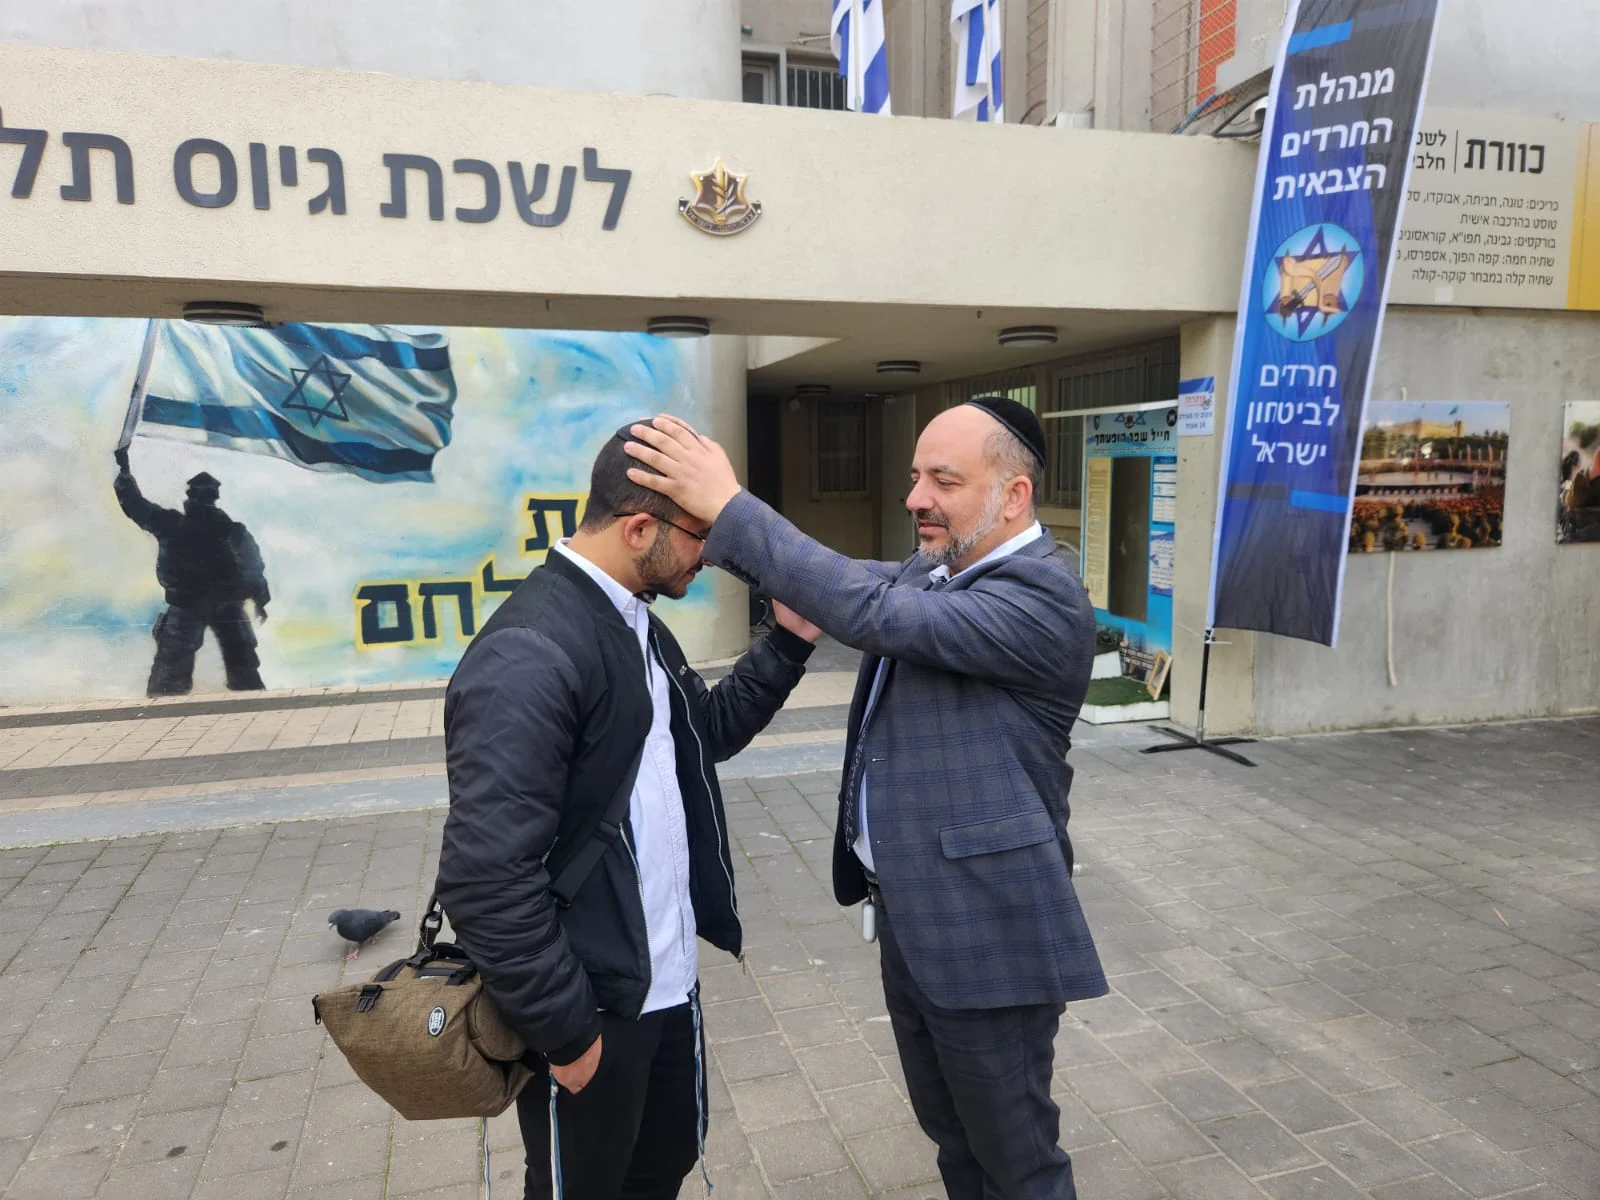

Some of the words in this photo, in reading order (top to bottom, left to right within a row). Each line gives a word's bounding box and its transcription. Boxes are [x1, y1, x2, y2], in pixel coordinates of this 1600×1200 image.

[1293, 67, 1395, 110] מנהלת
[1280, 117, 1394, 158] החרדים
[1416, 129, 1447, 147] לשכ
[0, 105, 135, 205] תל
[1463, 138, 1545, 174] כוורת
[172, 137, 346, 215] גיוס
[1272, 163, 1387, 200] הצבאית
[380, 146, 632, 231] לשכת
[1423, 191, 1461, 205] אבוקדו,
[1463, 194, 1497, 206] חביתה,
[1499, 197, 1524, 209] טונה,
[1526, 199, 1559, 211] כריכים:
[1460, 213, 1490, 225] אישית
[1492, 215, 1530, 229] בהרכבה
[1533, 218, 1557, 230] טוסט
[1478, 253, 1500, 266] קפה
[1502, 254, 1527, 265] חמה:
[1529, 255, 1555, 267] שתיה
[1412, 267, 1467, 284] קוקה-קולה
[1469, 271, 1503, 284] במבחר
[1505, 271, 1526, 287] קלה
[1528, 274, 1554, 286] שתיה
[1259, 364, 1337, 388] חרדים
[1246, 395, 1340, 430] לביטחון
[1151, 427, 1170, 441] חייל
[1251, 433, 1328, 465] ישראל
